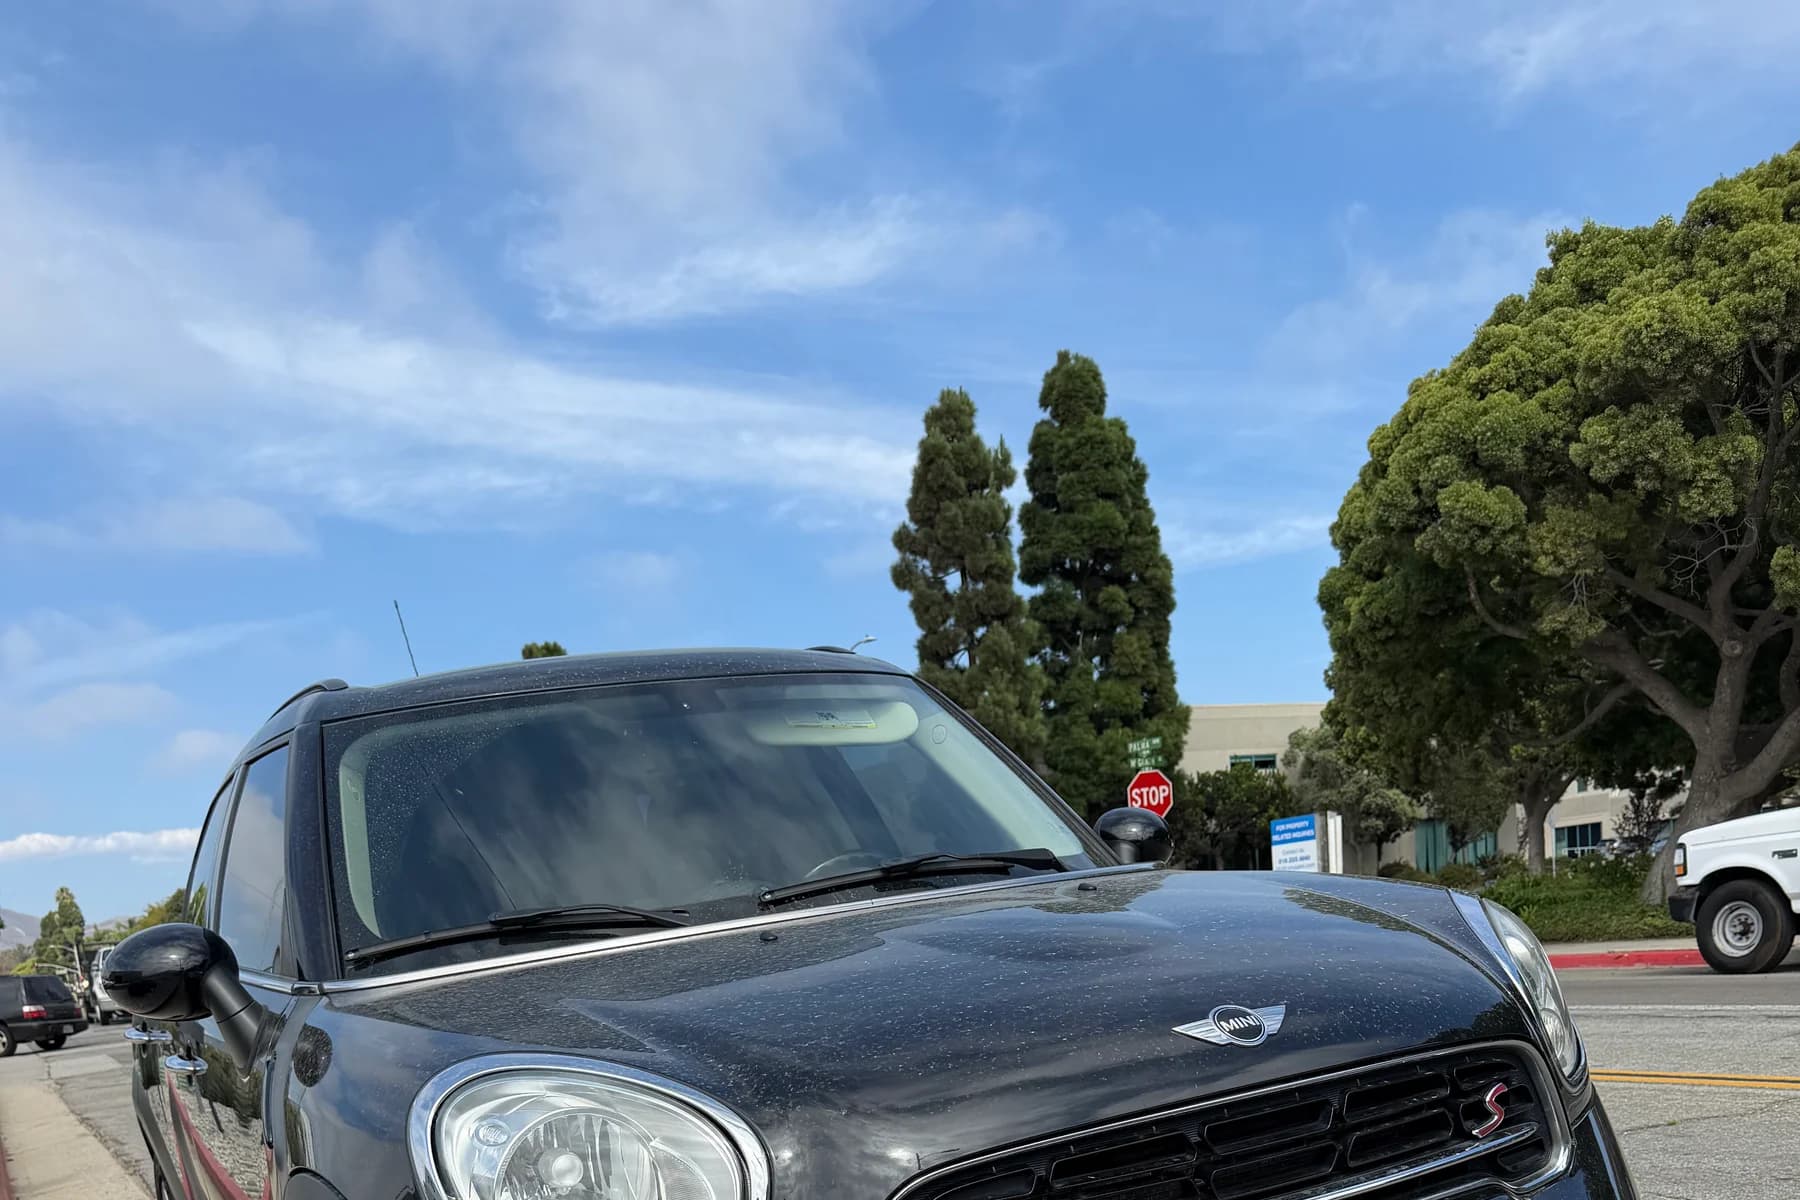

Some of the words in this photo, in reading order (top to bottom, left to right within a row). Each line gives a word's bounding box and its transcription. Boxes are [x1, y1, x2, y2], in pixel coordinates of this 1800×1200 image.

[1131, 785, 1169, 808] STOP
[1219, 1015, 1261, 1032] MINI
[1472, 1082, 1508, 1139] S
